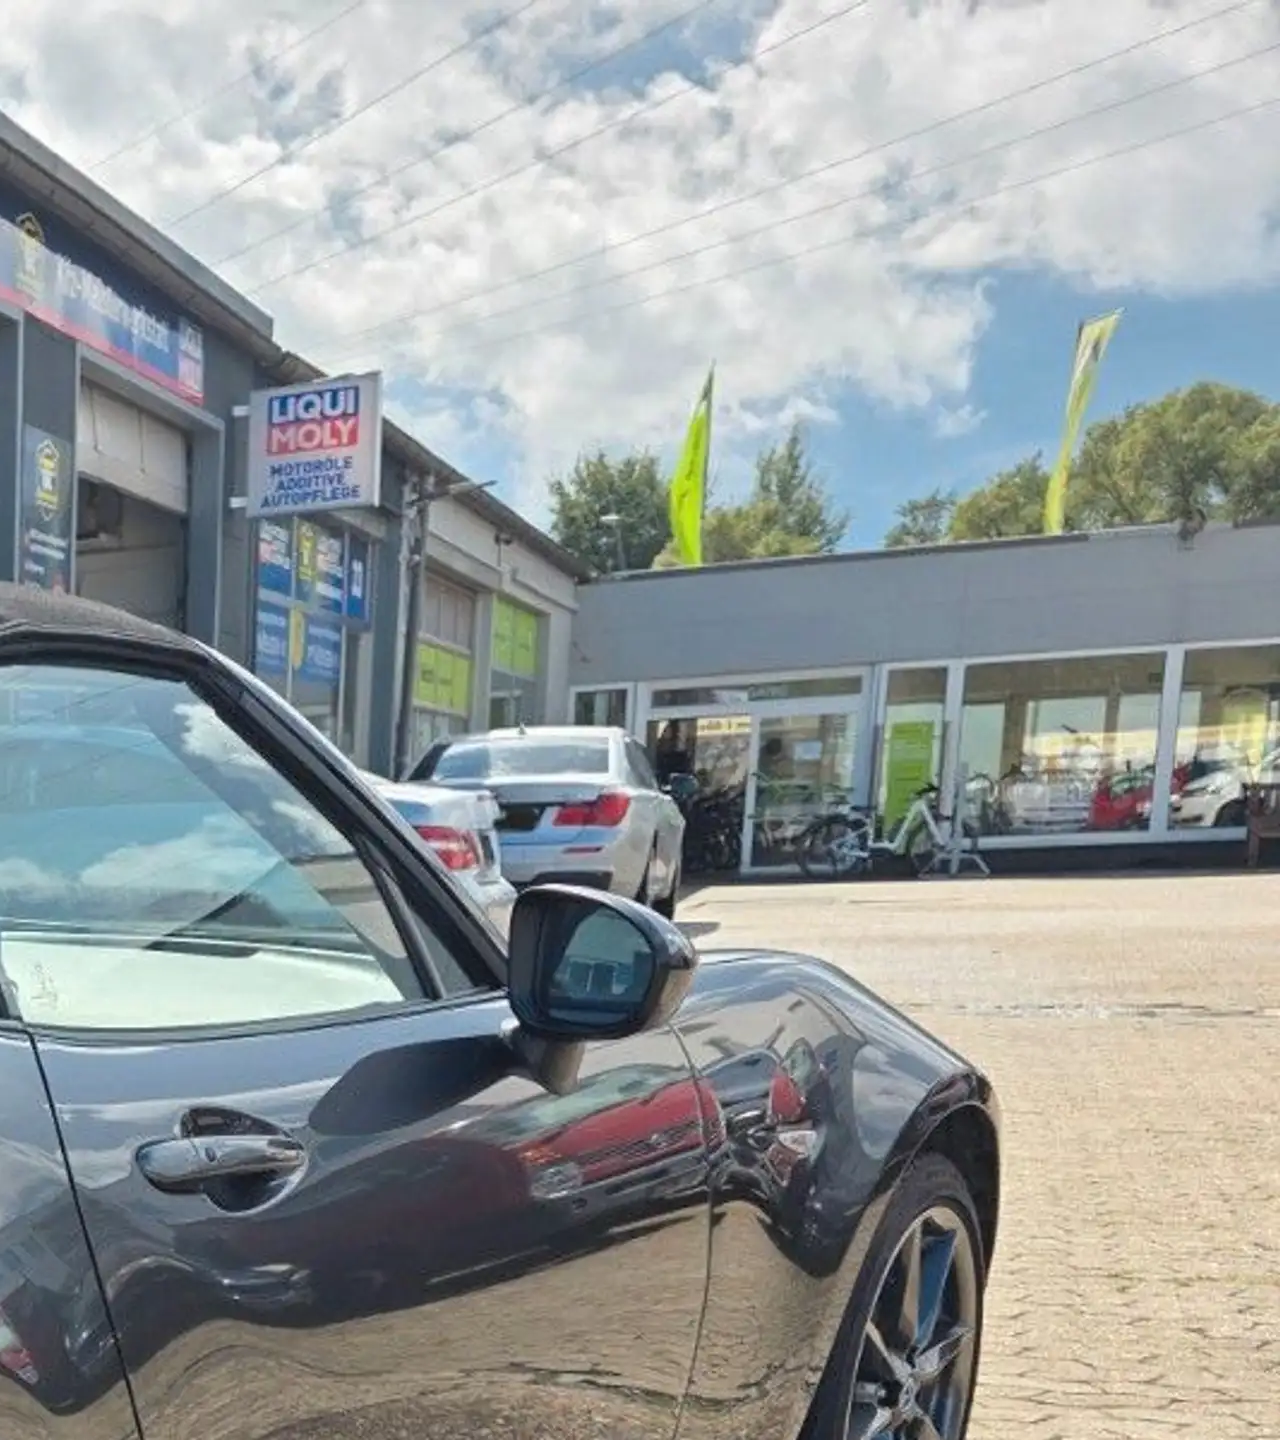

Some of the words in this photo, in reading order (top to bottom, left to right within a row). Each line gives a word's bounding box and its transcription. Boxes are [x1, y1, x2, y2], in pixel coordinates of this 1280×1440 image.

[271, 388, 356, 424] LIQUI
[271, 416, 357, 453] MOLY
[260, 484, 361, 509] AUTOPFLEGE
[276, 473, 346, 493] ADDITIVE
